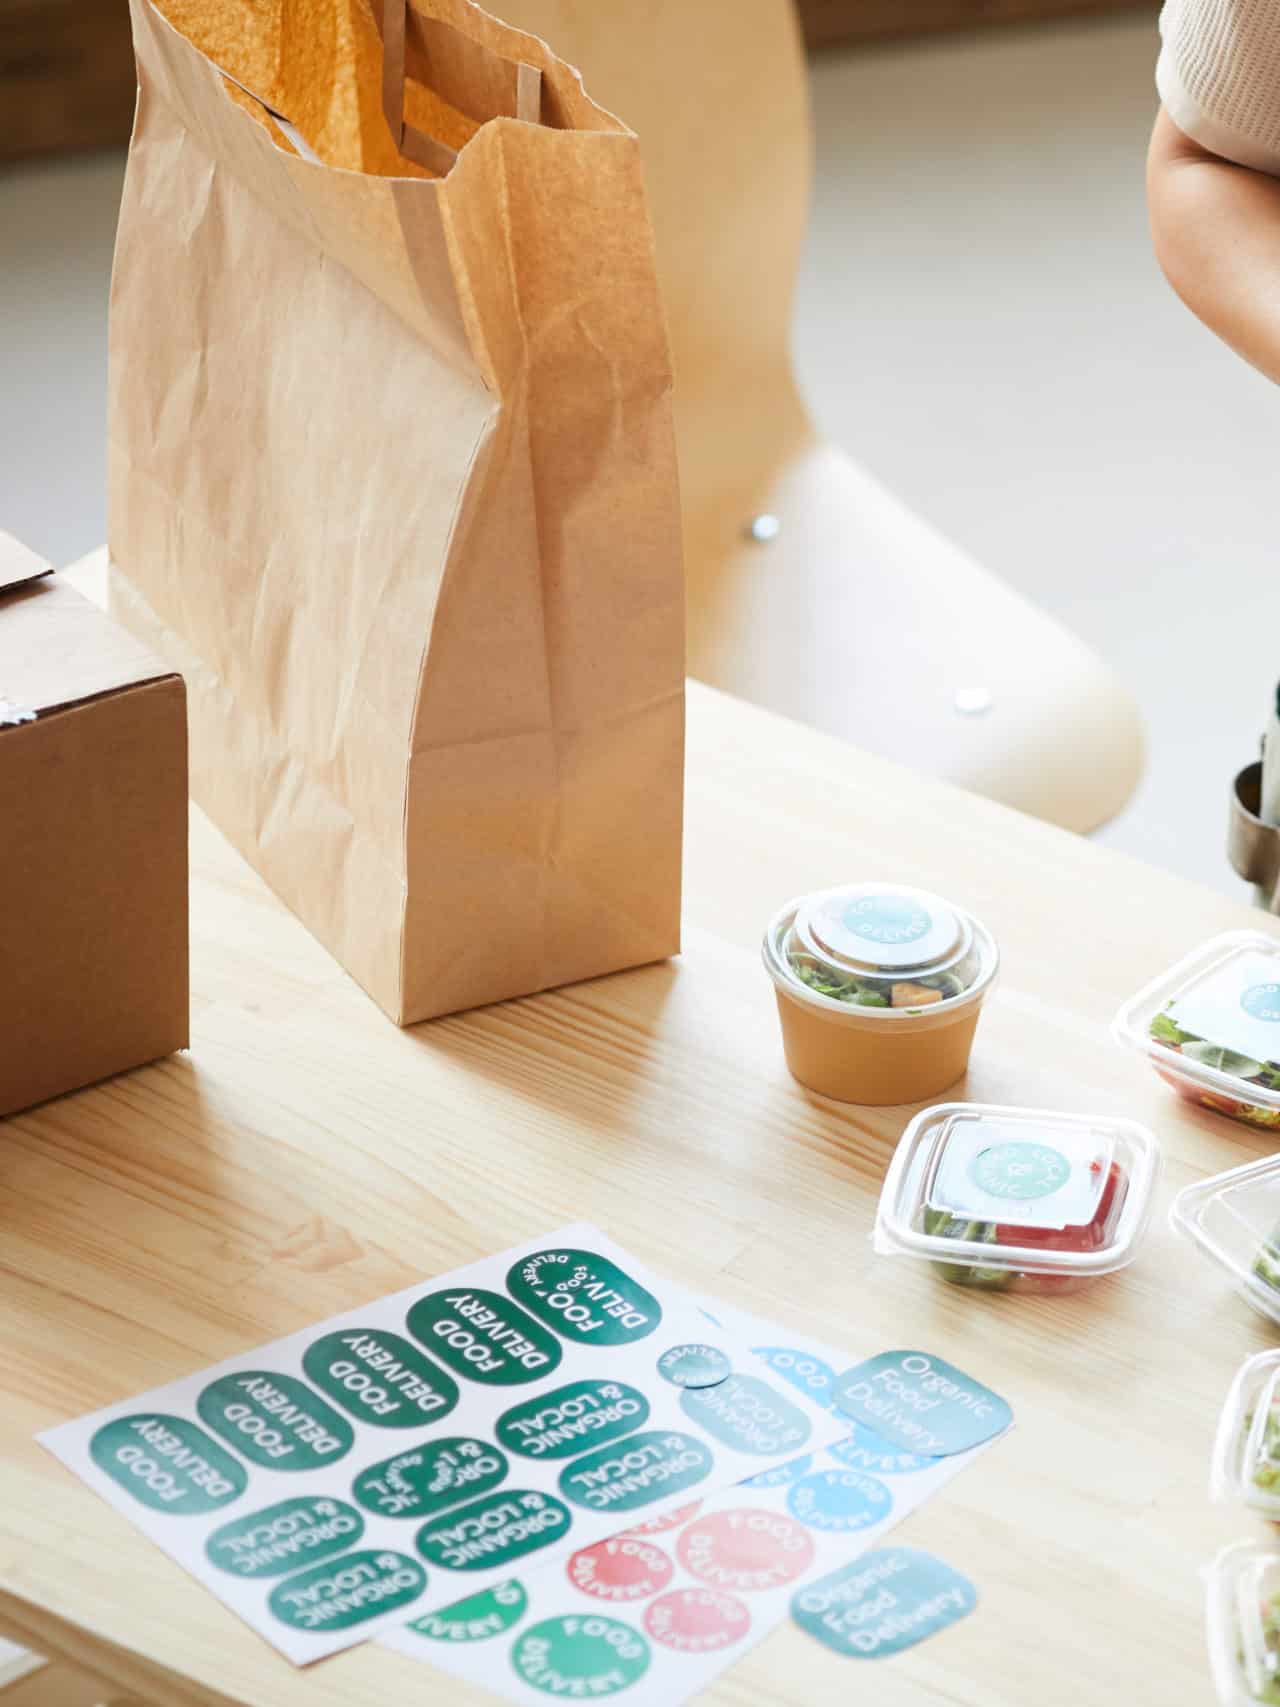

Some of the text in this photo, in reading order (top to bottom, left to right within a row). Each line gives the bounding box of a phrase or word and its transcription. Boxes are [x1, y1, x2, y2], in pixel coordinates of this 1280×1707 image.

[522, 1254, 570, 1287] DELIVERY
[557, 1265, 588, 1291] FOOD
[534, 1290, 604, 1333] FOO
[584, 1275, 649, 1329] DELIV
[432, 1319, 504, 1373] FOOD
[444, 1294, 550, 1369] DELIVERY
[329, 1360, 402, 1416] FOOD
[340, 1335, 447, 1412] DELIVERY
[872, 1368, 942, 1412] Food
[901, 1355, 994, 1418] Organic
[223, 1404, 295, 1458] FOOD
[237, 1377, 342, 1455] DELIVERY
[506, 1383, 623, 1437] & LOCAL
[521, 1398, 641, 1456] ORGANIC
[115, 1445, 188, 1502] FOOD
[130, 1418, 235, 1498] DELIVERY
[569, 1444, 664, 1489] LOCAL
[585, 1450, 704, 1507] ORGANIC
[218, 1509, 316, 1553] LOCAL
[233, 1515, 357, 1573] ORGANIC
[426, 1493, 547, 1547] & LOCAL
[441, 1506, 565, 1568] ORGANIC
[280, 1563, 377, 1606] LOCAL
[295, 1569, 420, 1628] ORGANIC
[519, 1635, 627, 1697] DELIVERY
[561, 1618, 644, 1660] FOOD
